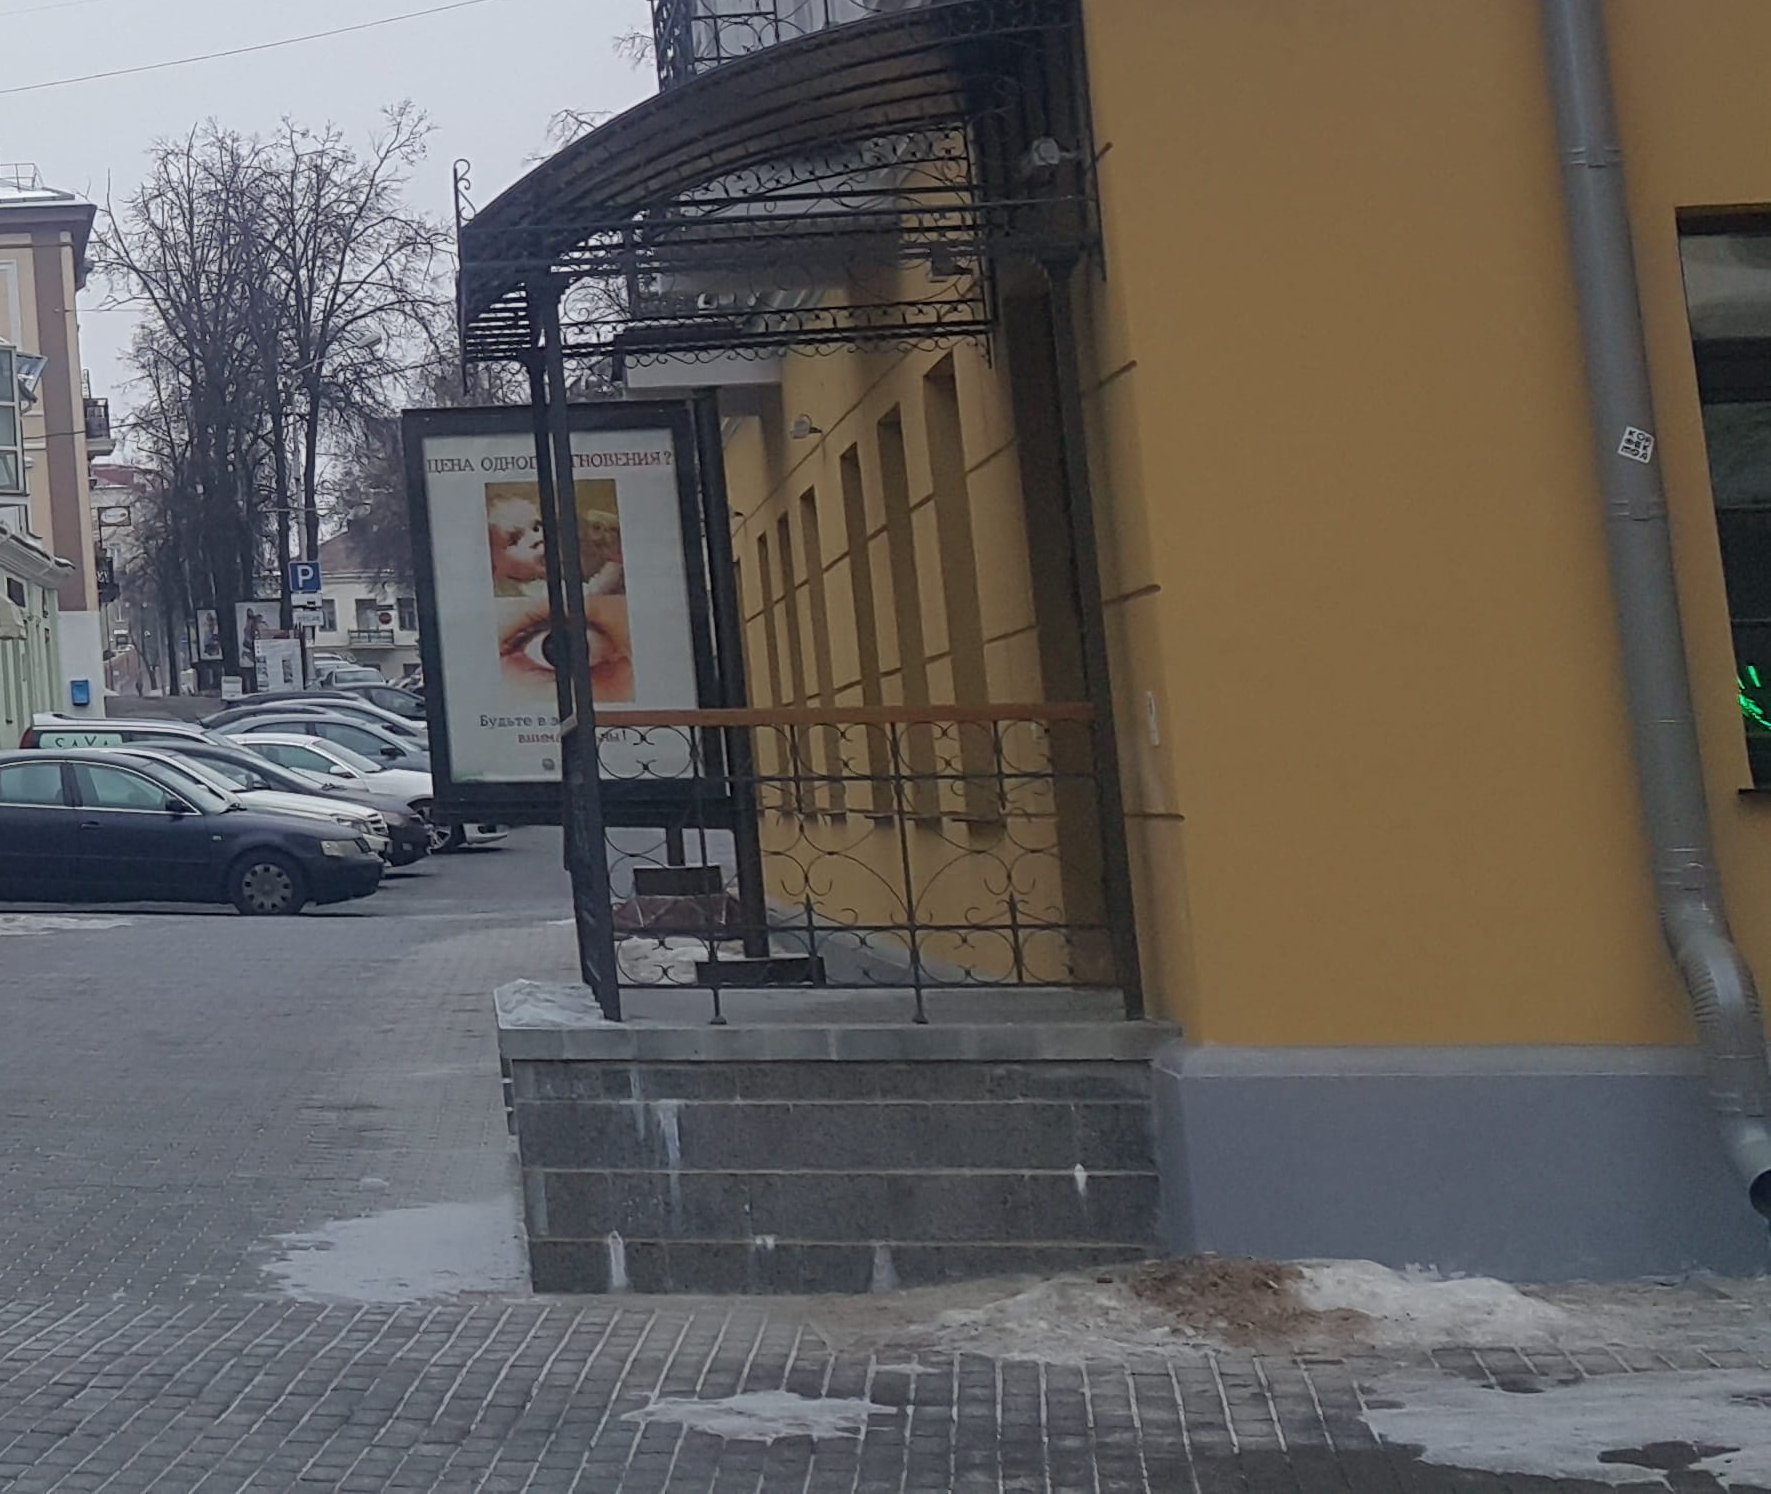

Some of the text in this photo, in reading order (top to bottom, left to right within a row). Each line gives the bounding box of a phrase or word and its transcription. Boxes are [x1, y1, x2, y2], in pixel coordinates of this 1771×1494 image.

[427, 457, 475, 474] ЦЕНА
[480, 455, 538, 472] ОДНОГ
[297, 564, 314, 588] P
[479, 714, 532, 728] Будьте
